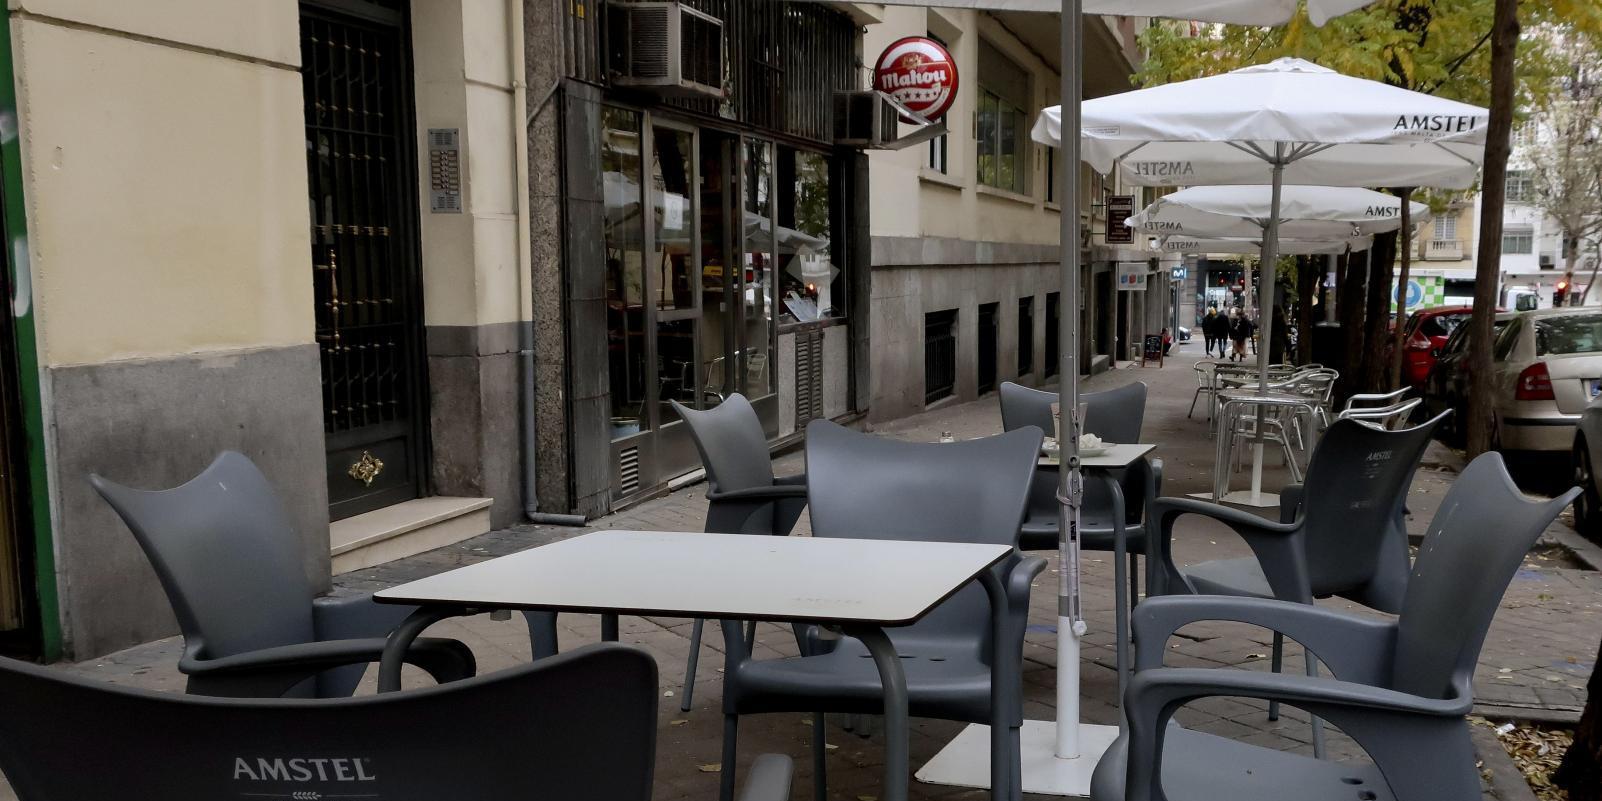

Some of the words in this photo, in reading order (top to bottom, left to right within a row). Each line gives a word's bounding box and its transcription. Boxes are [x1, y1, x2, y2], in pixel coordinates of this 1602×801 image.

[881, 69, 946, 89] Mahou
[1393, 115, 1476, 132] AMSTEL
[1365, 205, 1400, 217] AMST
[233, 757, 376, 781] AMSTEL
